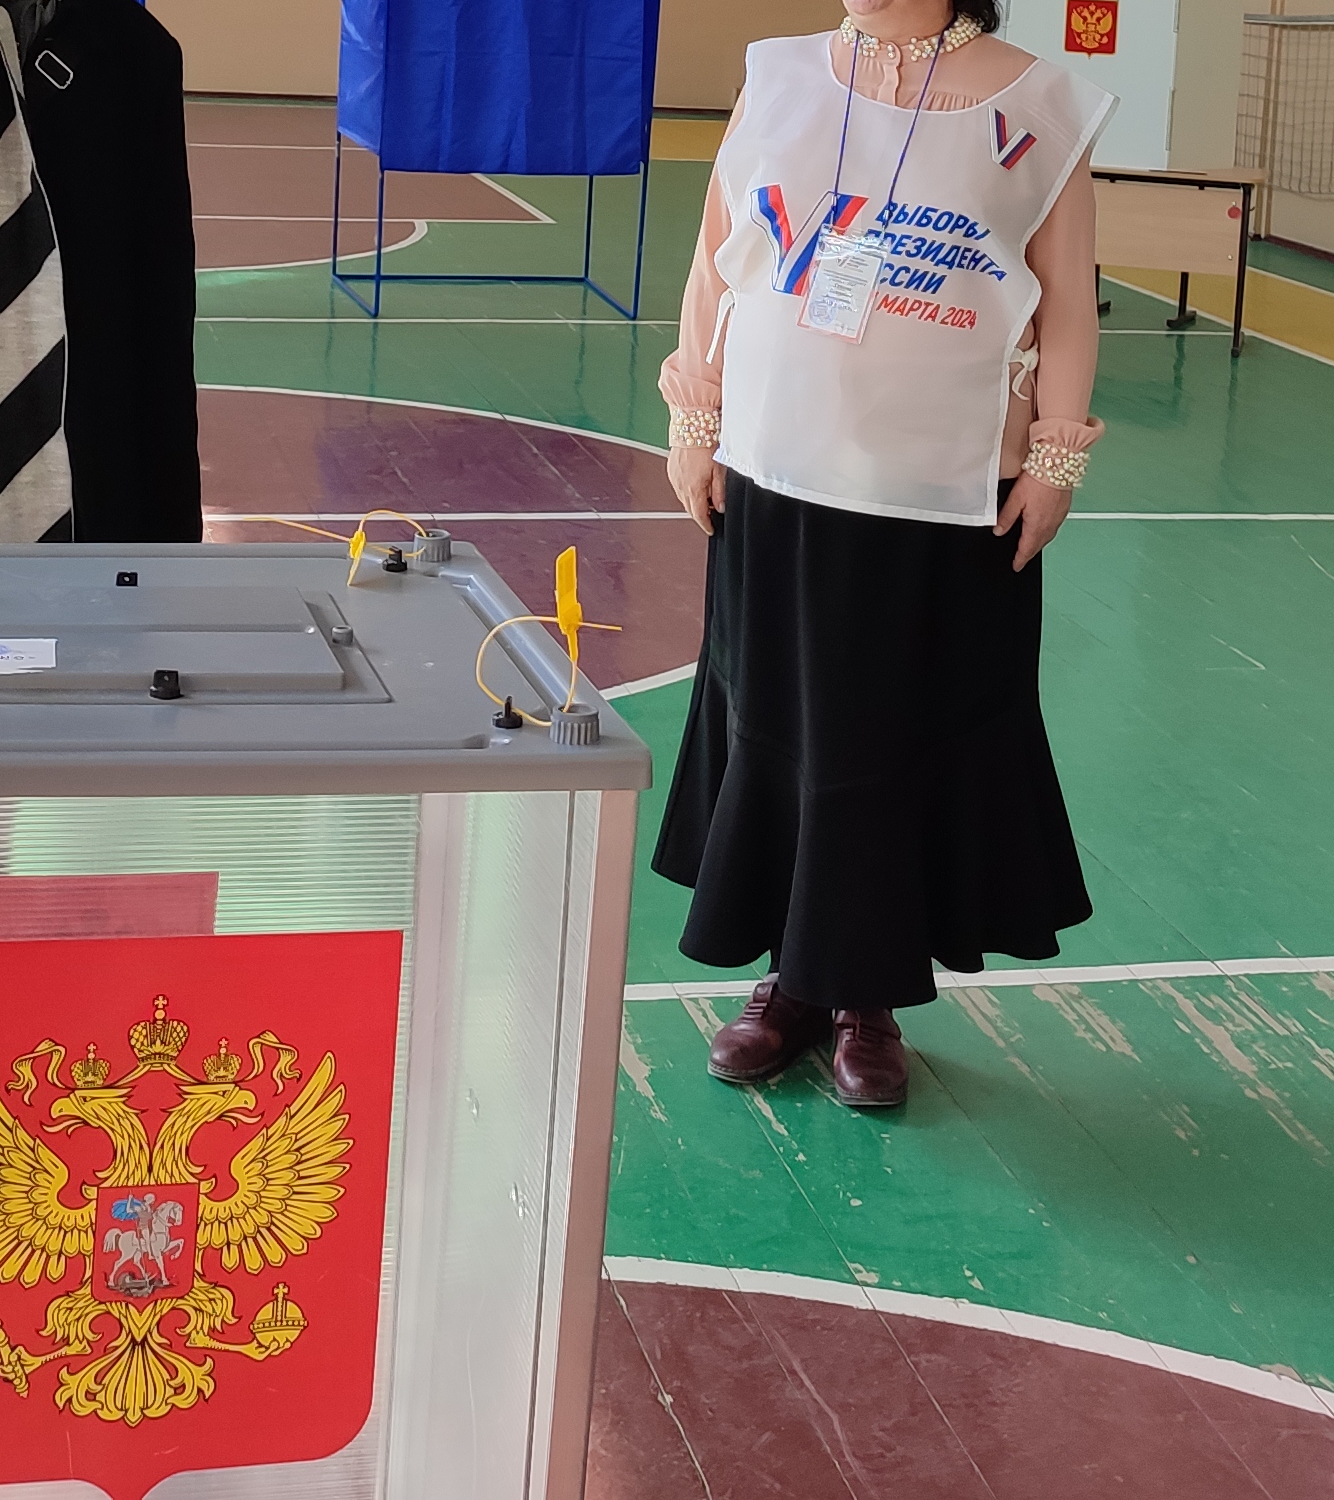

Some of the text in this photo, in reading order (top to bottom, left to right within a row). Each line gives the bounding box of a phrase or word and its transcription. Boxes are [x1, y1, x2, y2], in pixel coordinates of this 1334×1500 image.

[875, 201, 991, 241] ВЫБОРЫ
[876, 293, 941, 323] МАРТА
[939, 306, 978, 330] 2024
